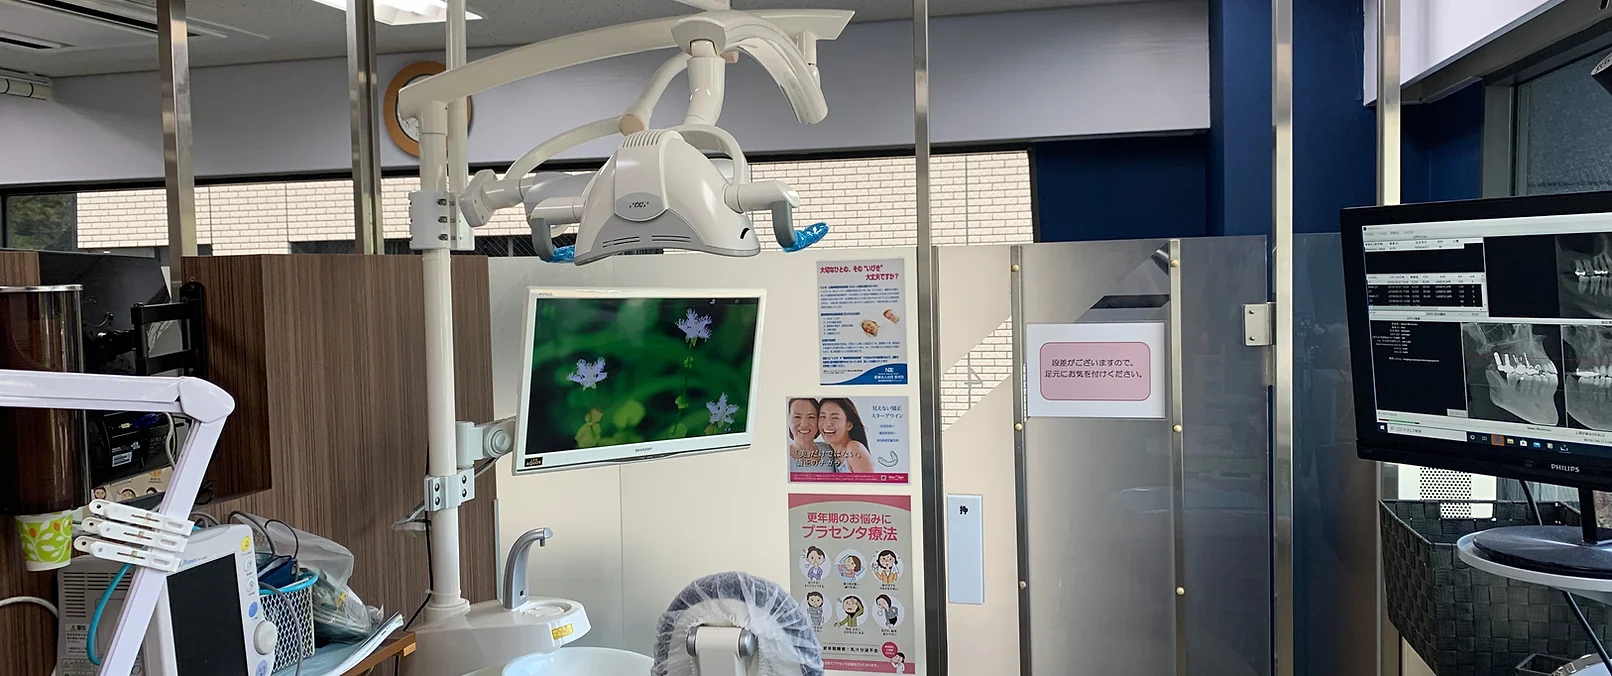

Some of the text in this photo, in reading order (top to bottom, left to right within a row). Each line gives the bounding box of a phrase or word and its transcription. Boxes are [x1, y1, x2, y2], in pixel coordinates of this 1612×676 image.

[1051, 359, 1134, 367] 段差がございますので、
[1045, 370, 1142, 378] 足元にお気を付けください。
[1551, 464, 1580, 473] PHILIPS
[807, 512, 892, 524] 更年期のお悩みに
[802, 525, 898, 541] プラセンタ療法
